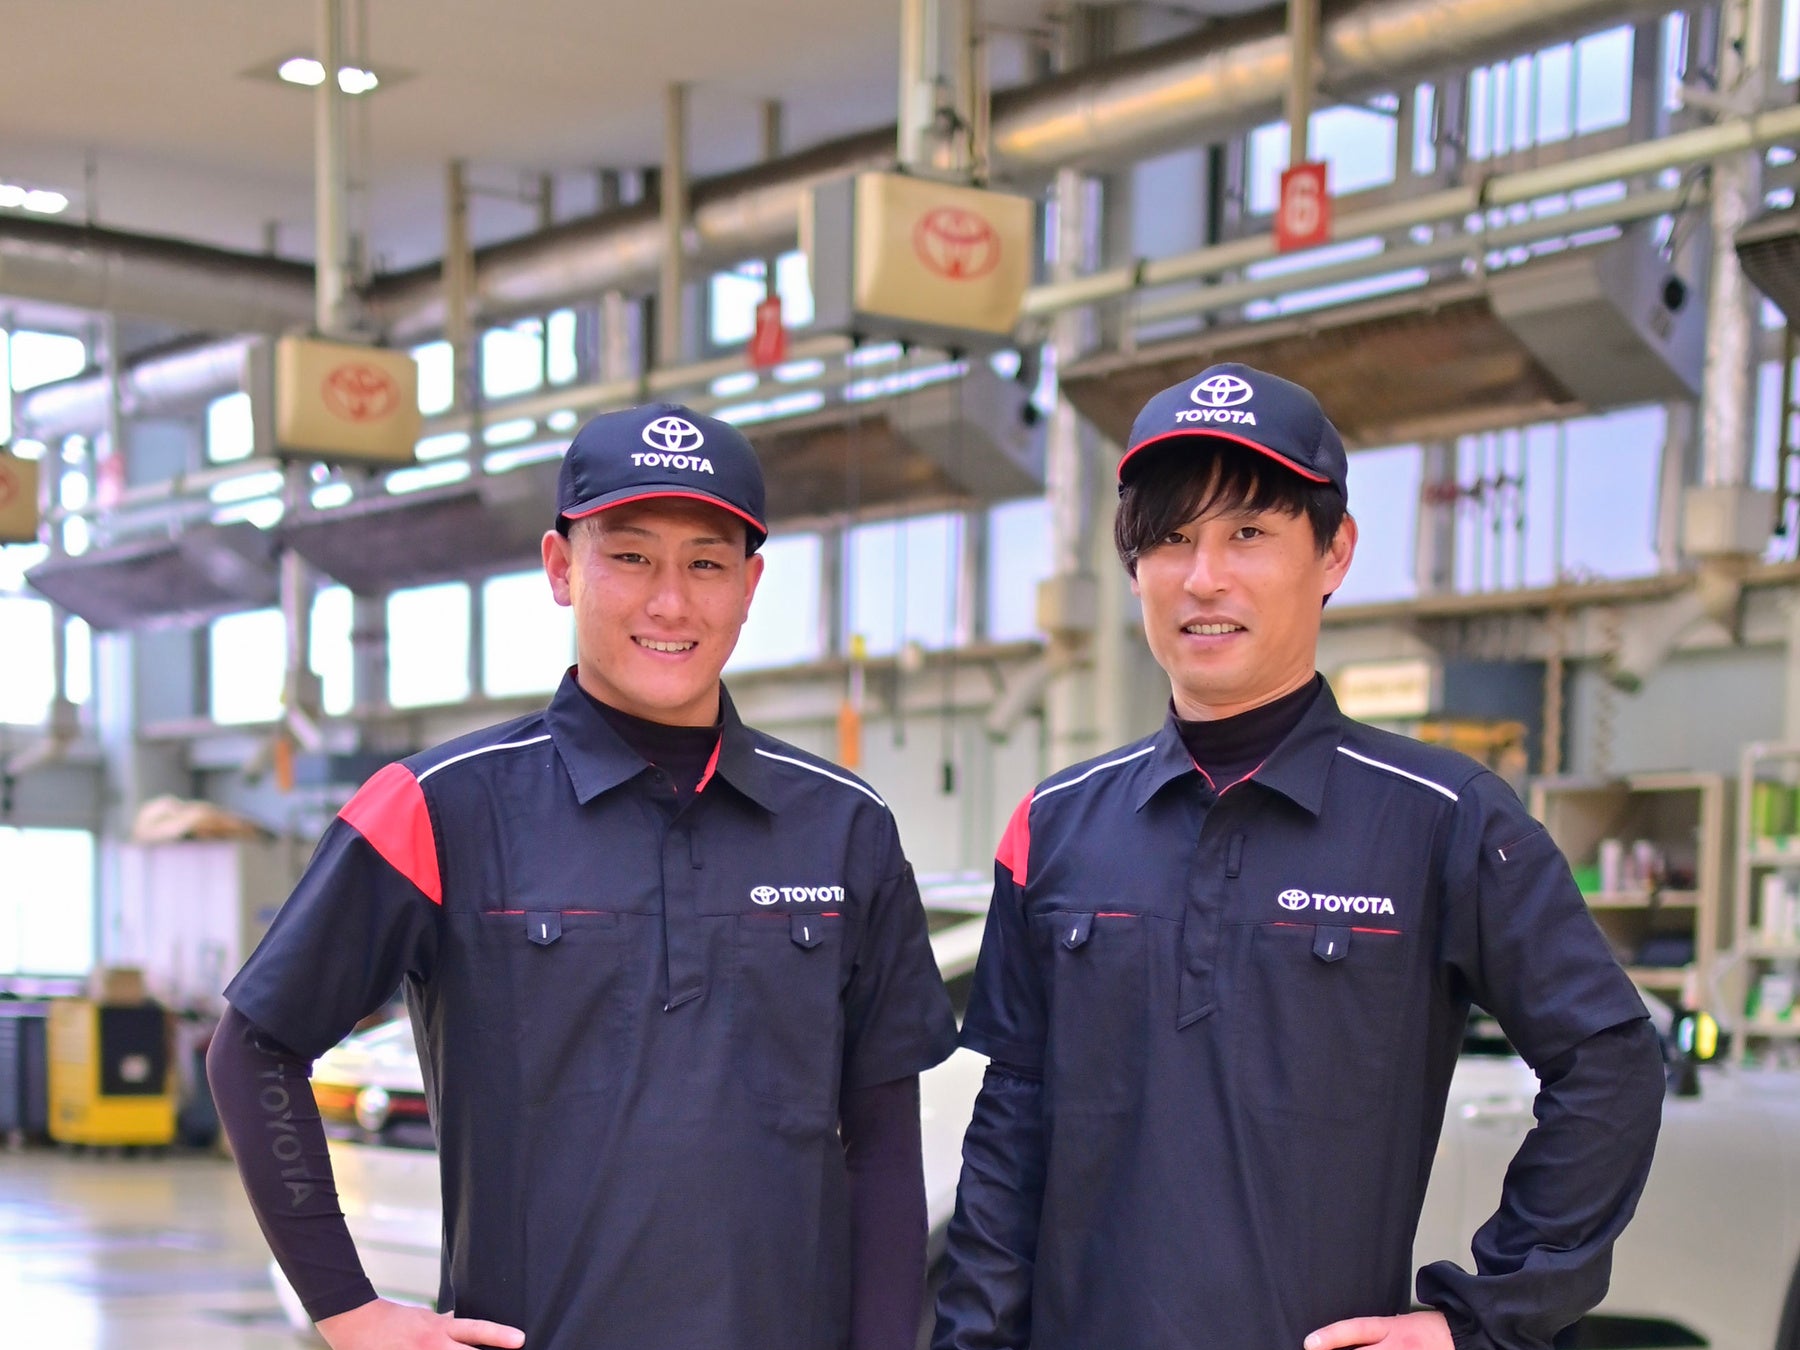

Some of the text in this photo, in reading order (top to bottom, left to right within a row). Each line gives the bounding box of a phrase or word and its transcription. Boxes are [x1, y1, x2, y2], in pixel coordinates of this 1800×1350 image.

[1285, 173, 1320, 236] 6
[1175, 409, 1256, 426] TOYOTA
[631, 453, 714, 475] TOYOTA
[1312, 893, 1395, 915] TOYOTA
[257, 1063, 315, 1208] TOYOTA
